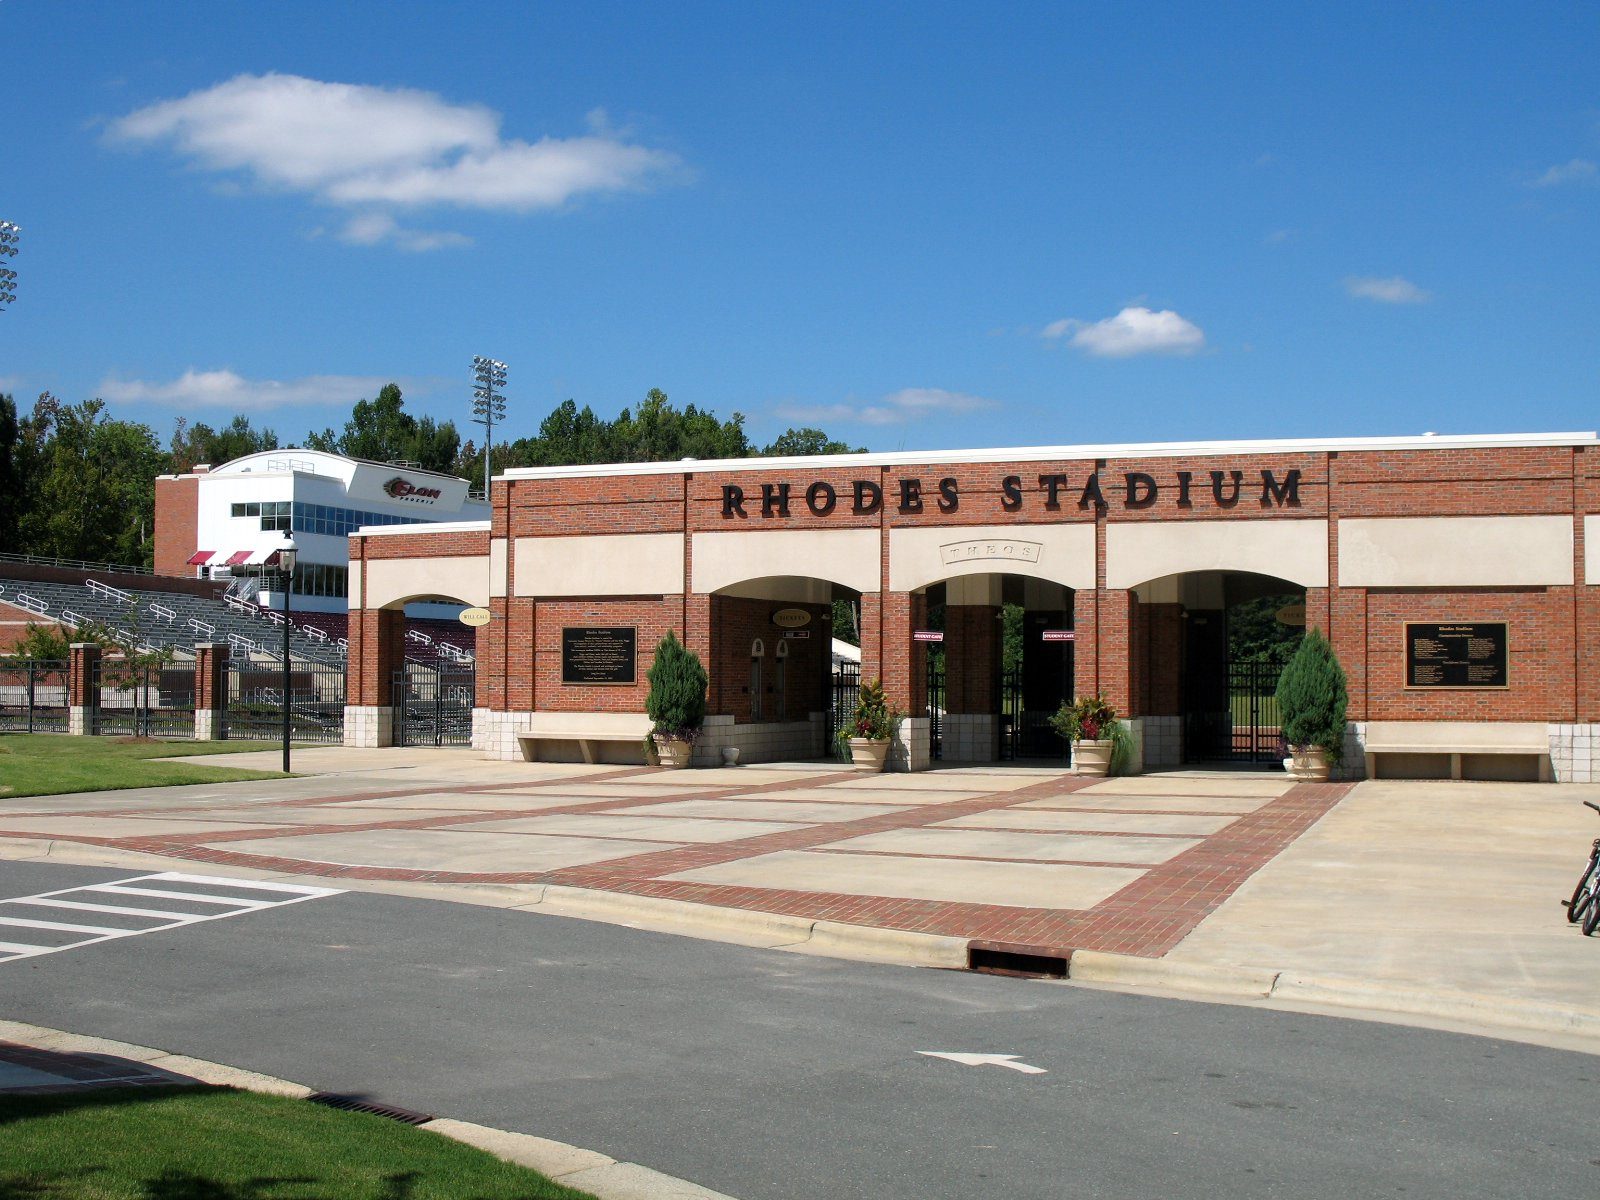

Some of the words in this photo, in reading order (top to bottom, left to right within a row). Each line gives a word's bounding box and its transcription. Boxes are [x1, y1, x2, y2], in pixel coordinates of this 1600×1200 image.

[393, 480, 441, 499] ELON
[720, 477, 959, 518] RHODES
[1000, 469, 1303, 512] STADIUM
